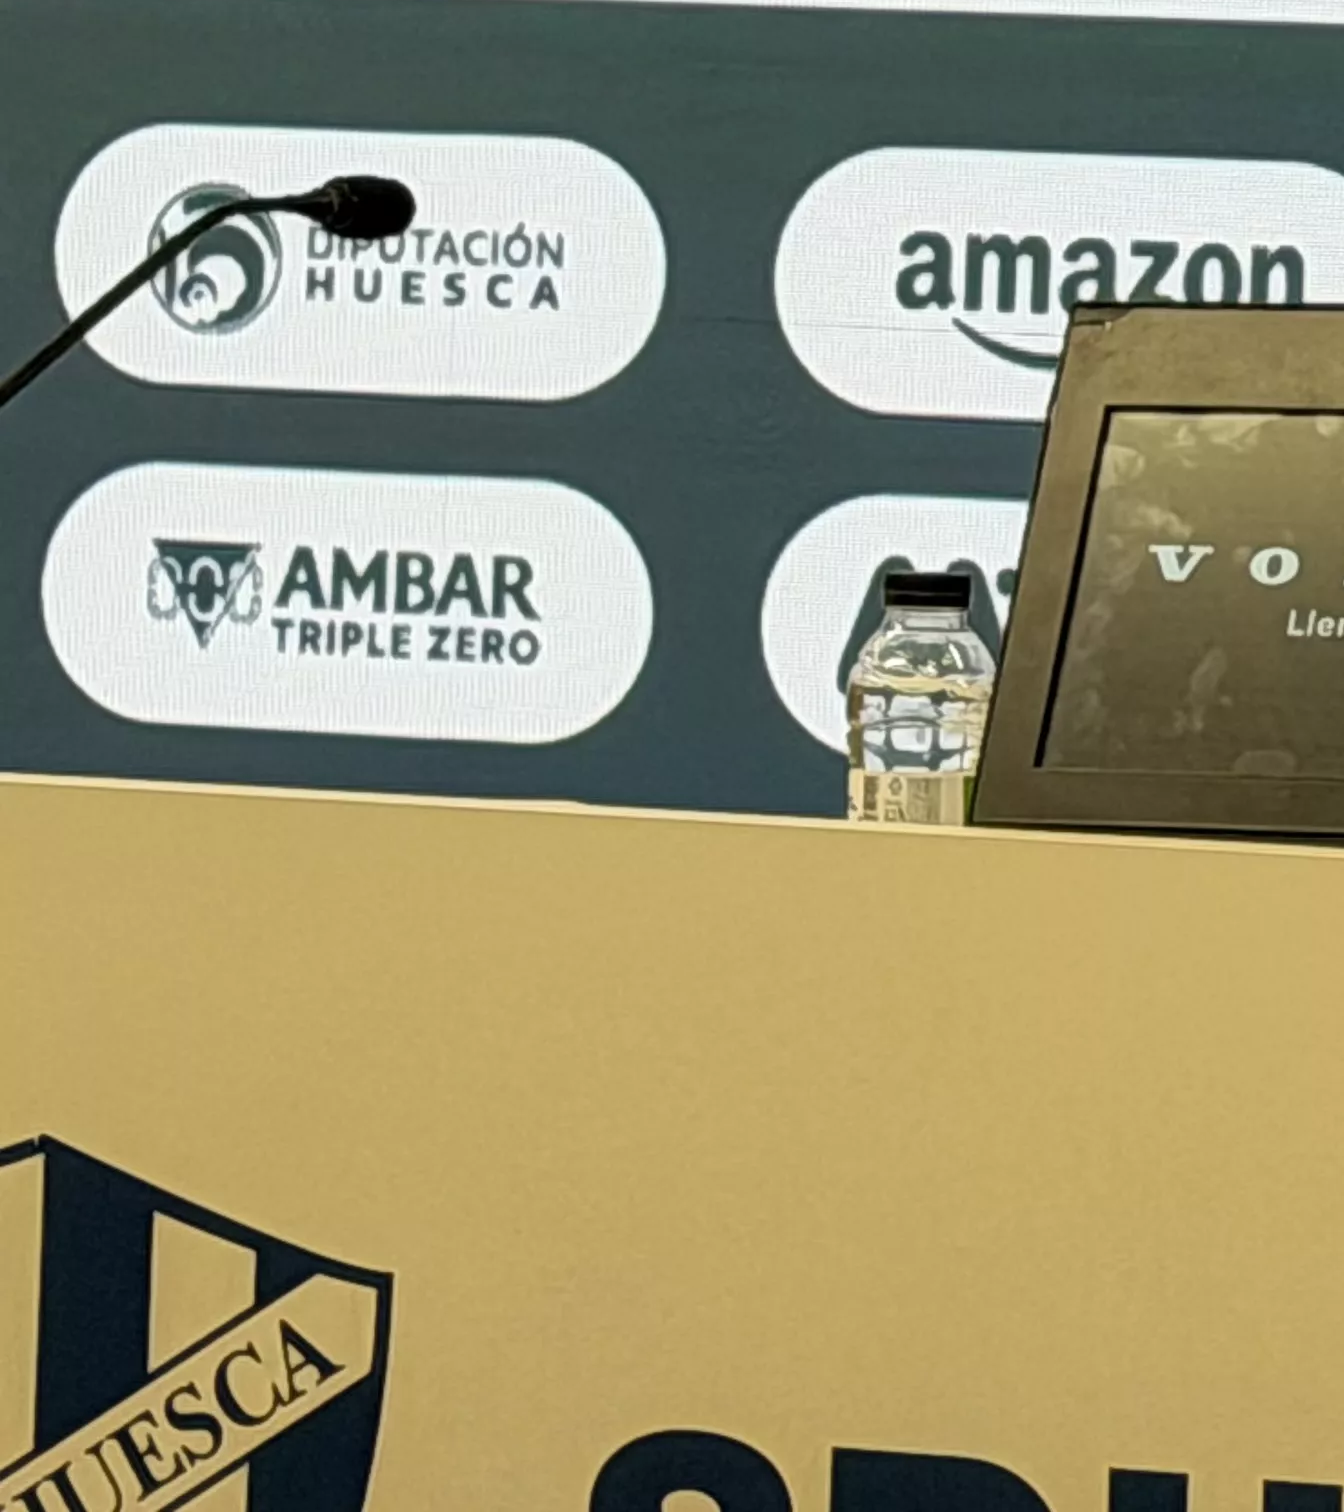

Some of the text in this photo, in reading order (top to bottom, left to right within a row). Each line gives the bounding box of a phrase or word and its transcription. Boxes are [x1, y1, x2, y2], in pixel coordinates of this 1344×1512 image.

[306, 265, 560, 311] HUESCA
[896, 230, 1306, 314] amazon
[273, 545, 542, 623] AMBAR
[272, 618, 540, 665] TRIPLE ZERO
